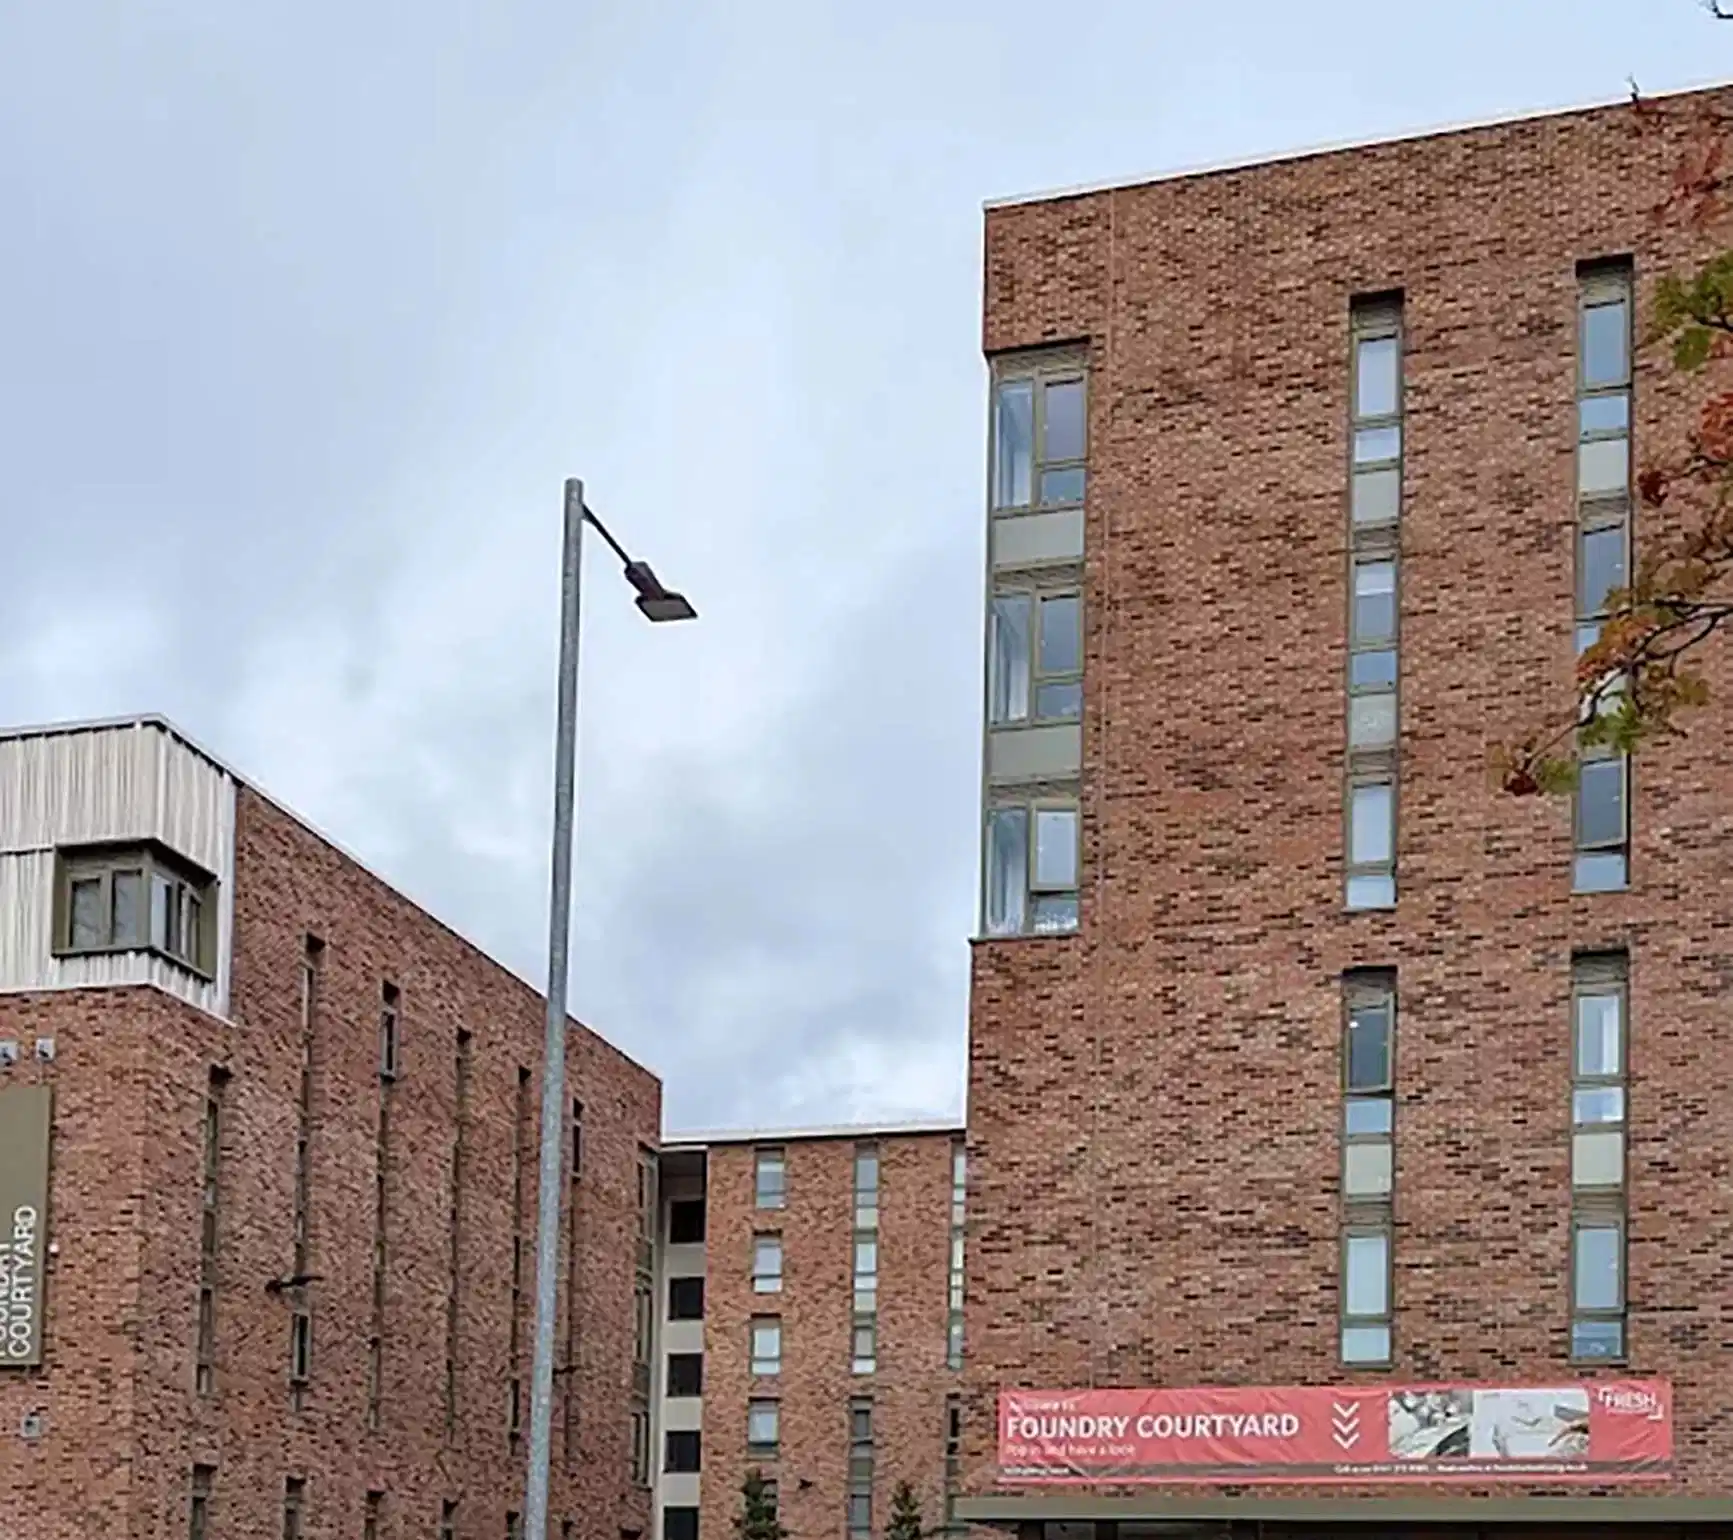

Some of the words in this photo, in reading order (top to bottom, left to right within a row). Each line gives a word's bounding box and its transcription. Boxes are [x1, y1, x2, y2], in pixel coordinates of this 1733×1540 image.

[8, 1205, 37, 1358] COURTYARD
[1006, 1415, 1130, 1439] FOUNDRY
[1136, 1413, 1300, 1439] COURTYARD
